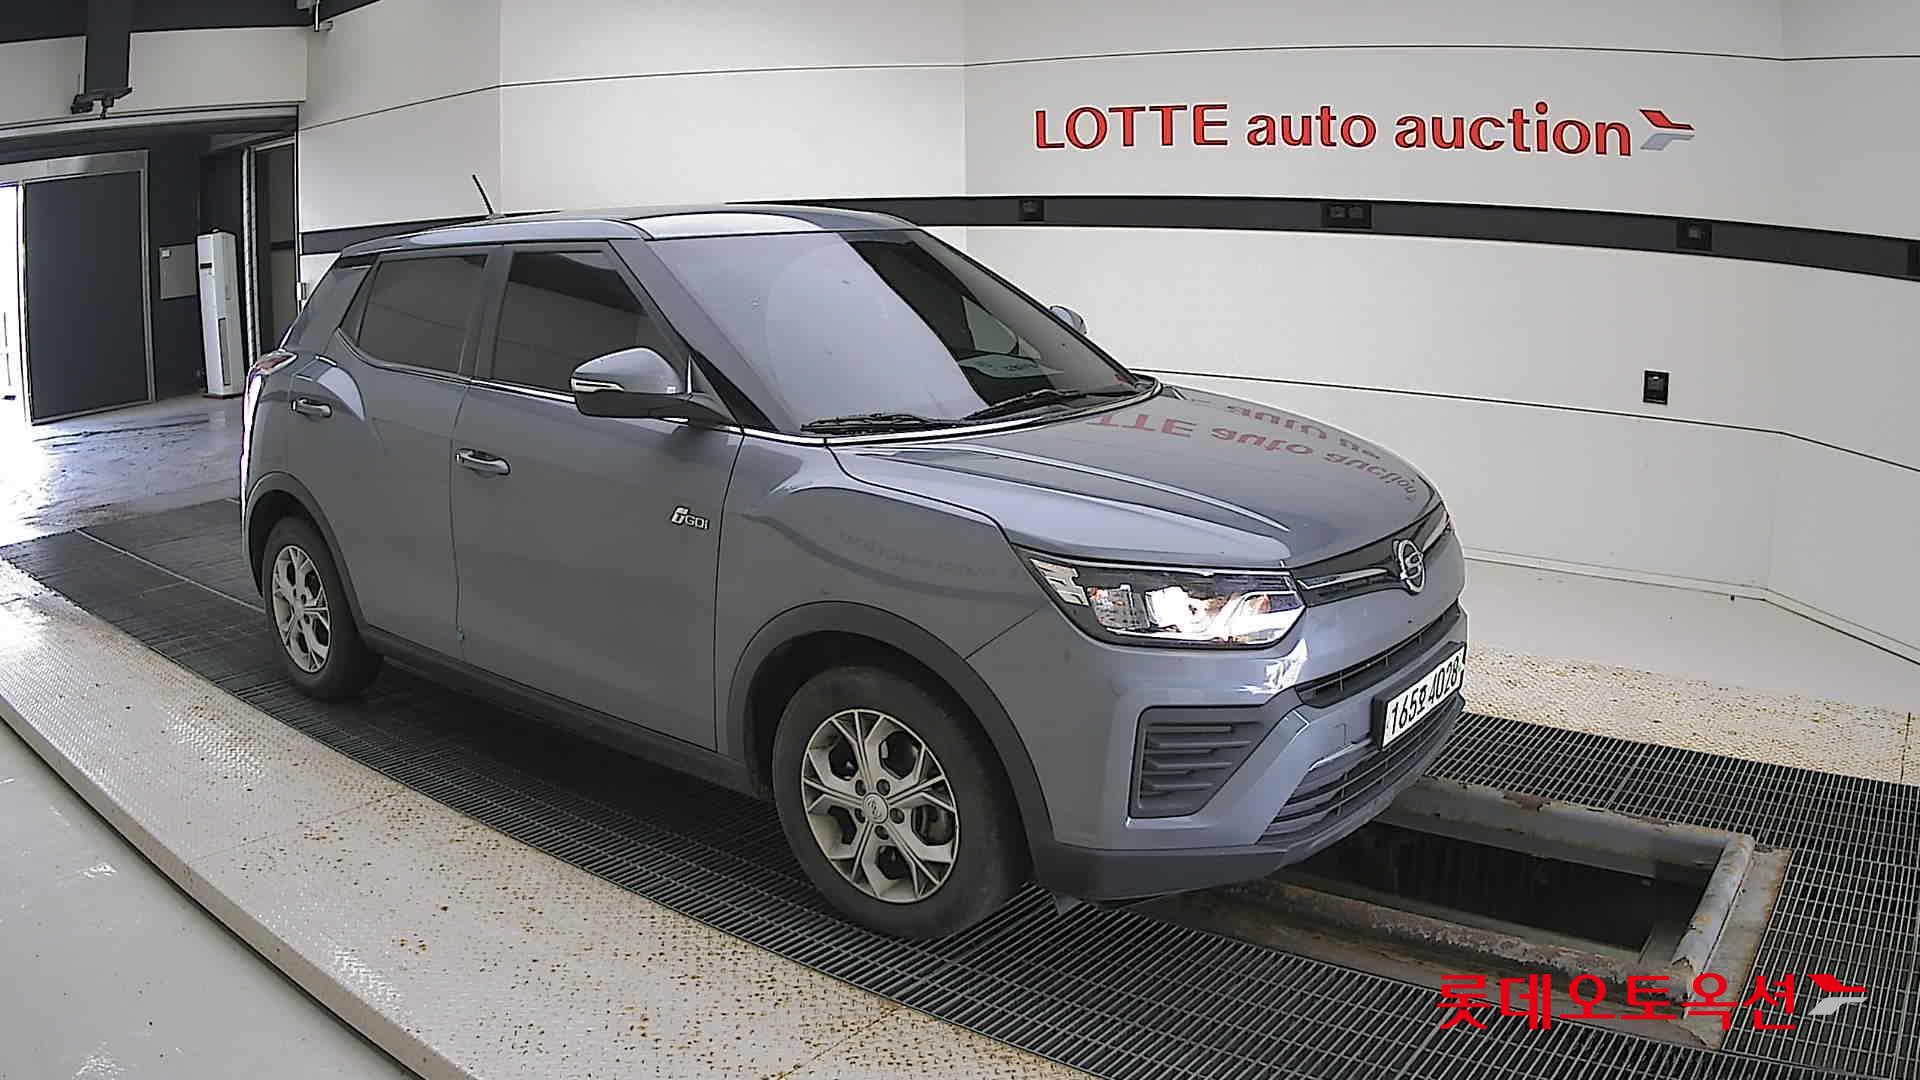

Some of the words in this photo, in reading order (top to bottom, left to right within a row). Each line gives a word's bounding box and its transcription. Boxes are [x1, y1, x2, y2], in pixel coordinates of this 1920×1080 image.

[1034, 103, 1229, 150] LOTTE
[1246, 104, 1377, 150] auto
[1394, 101, 1632, 157] auction
